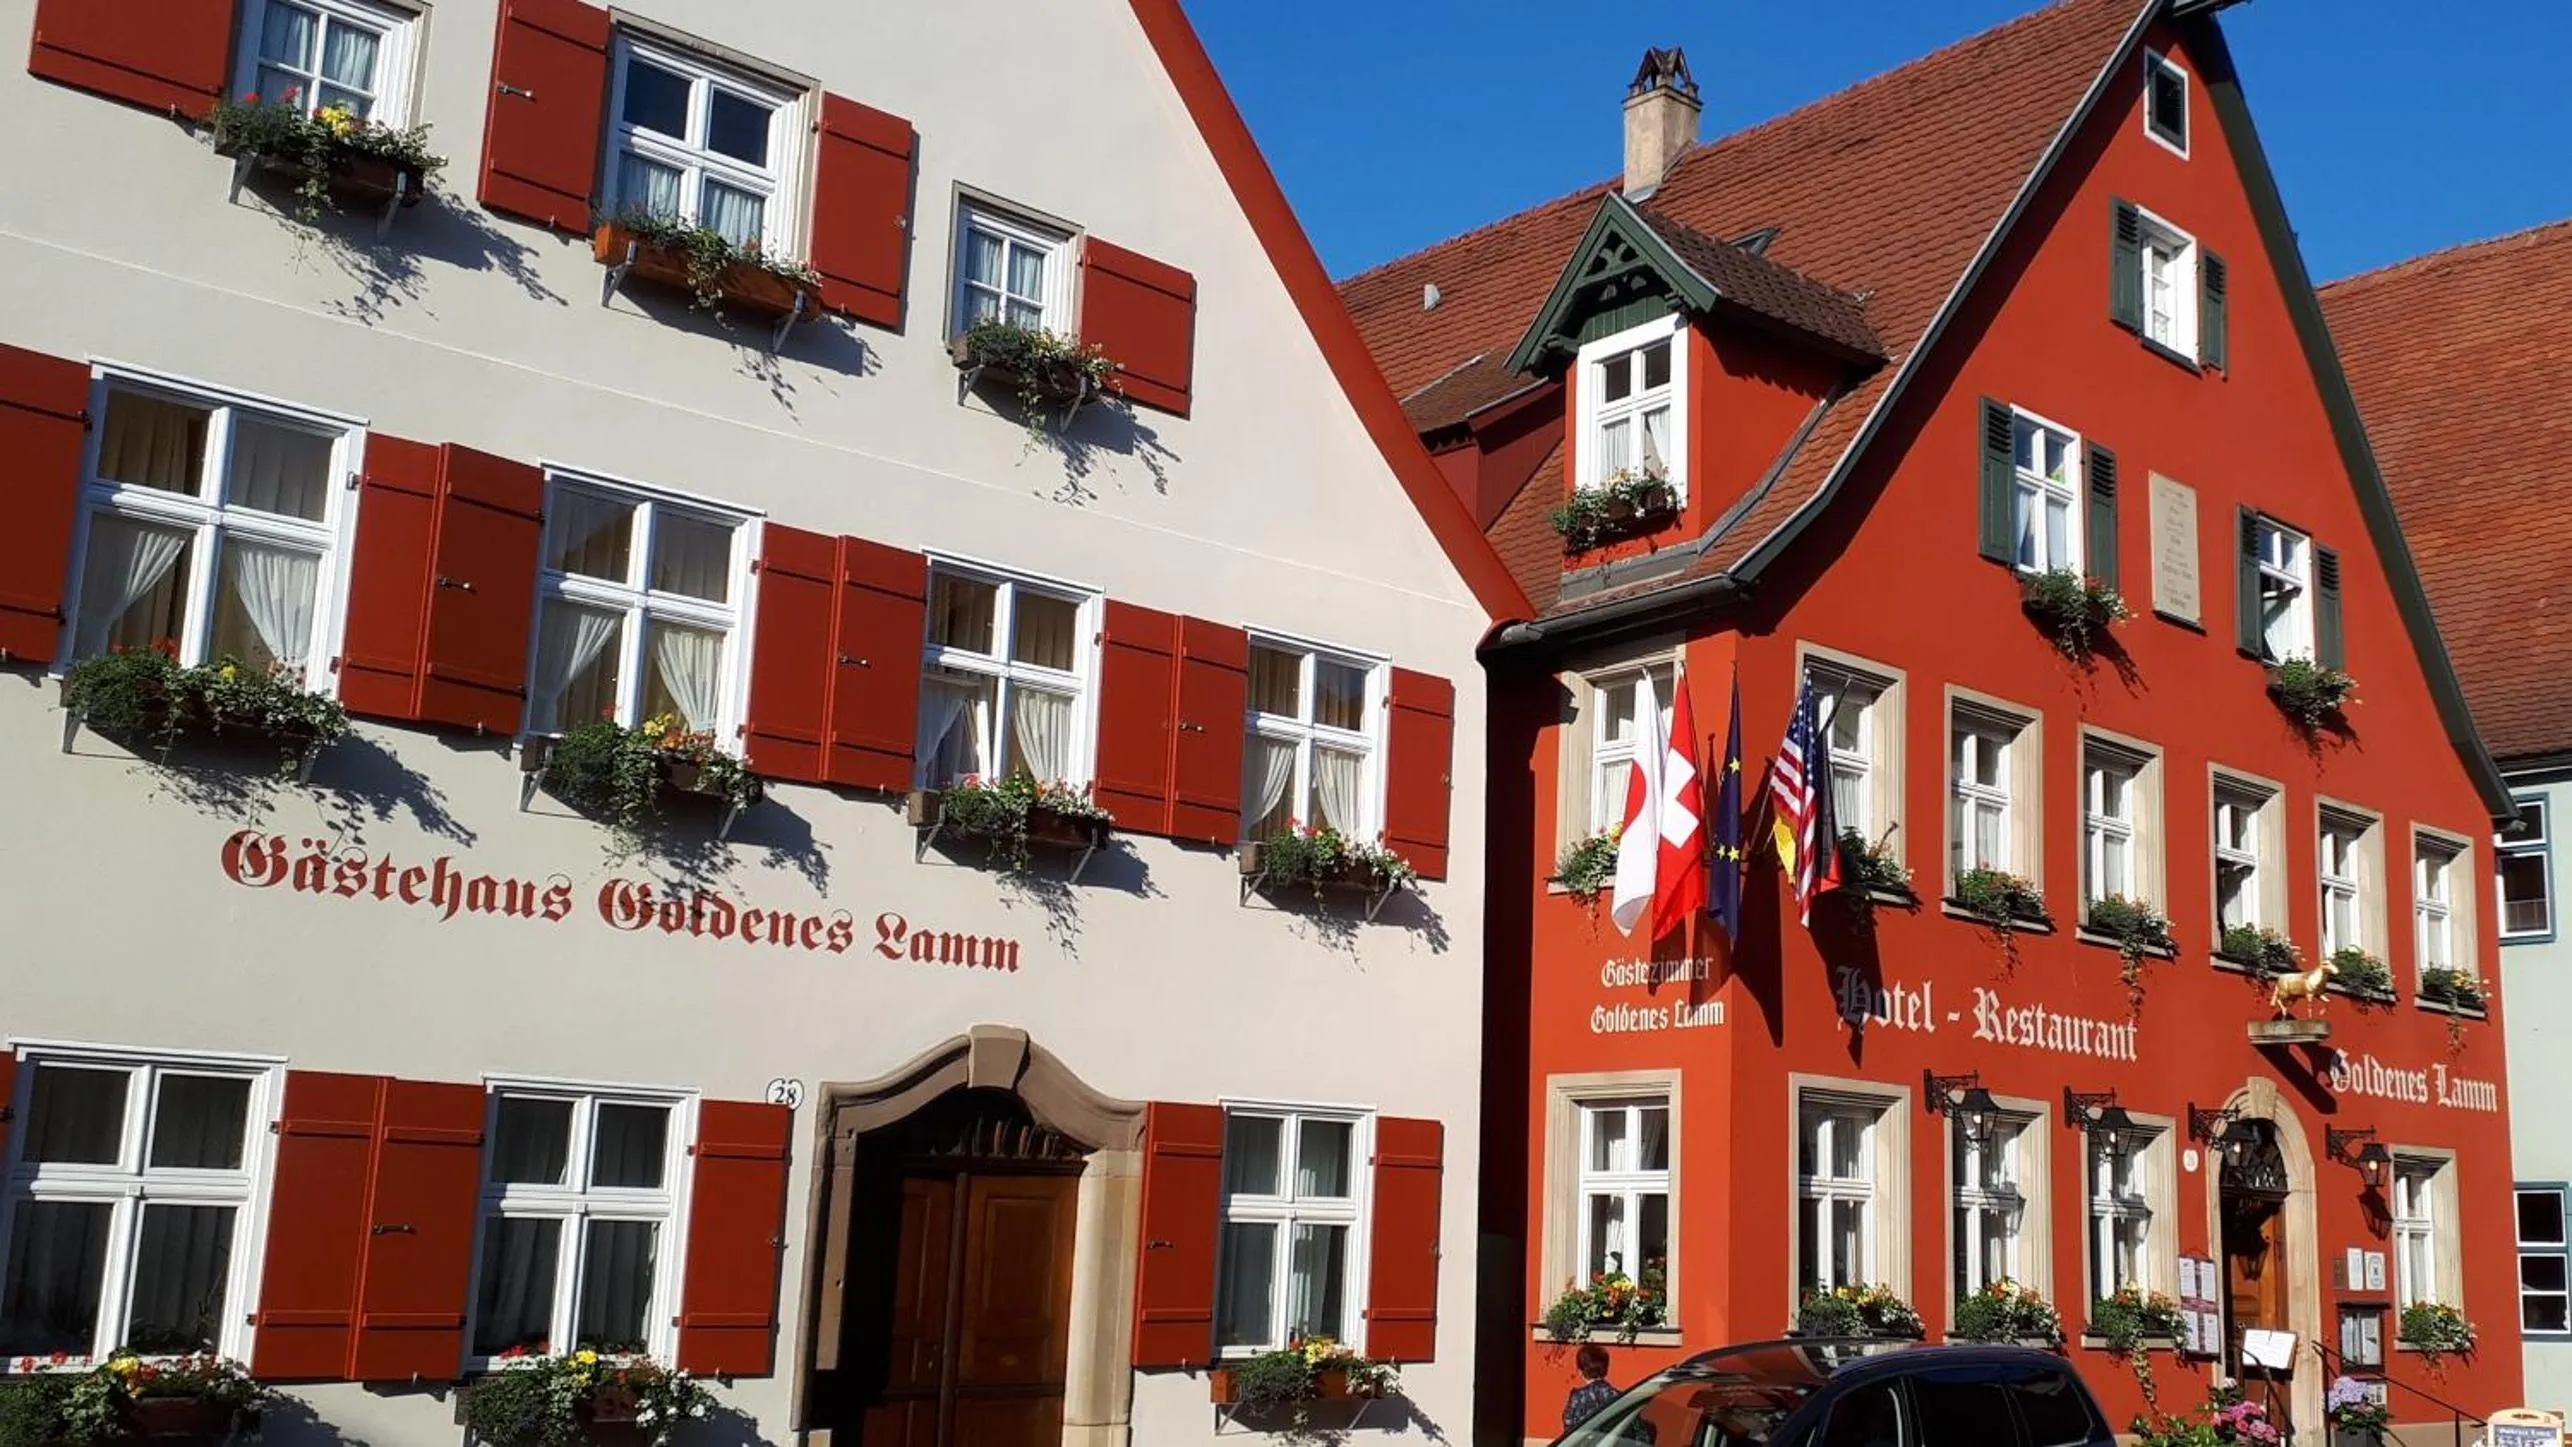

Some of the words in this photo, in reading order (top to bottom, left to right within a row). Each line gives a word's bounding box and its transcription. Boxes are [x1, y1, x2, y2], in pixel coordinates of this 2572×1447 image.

[221, 829, 573, 922] Gästehaus
[598, 878, 854, 955] Goldenes
[873, 912, 1021, 973] Lamm
[1601, 955, 1714, 988] Gästezimmer
[1590, 1001, 1669, 1034] Goldenes
[1673, 997, 1724, 1028] Lamm
[1835, 965, 1936, 1033] Hotel
[1972, 986, 2137, 1062] Restaurant
[774, 1086, 797, 1105] 28
[2330, 1047, 2429, 1104] Goldenes
[2432, 1062, 2498, 1113] Lamm
